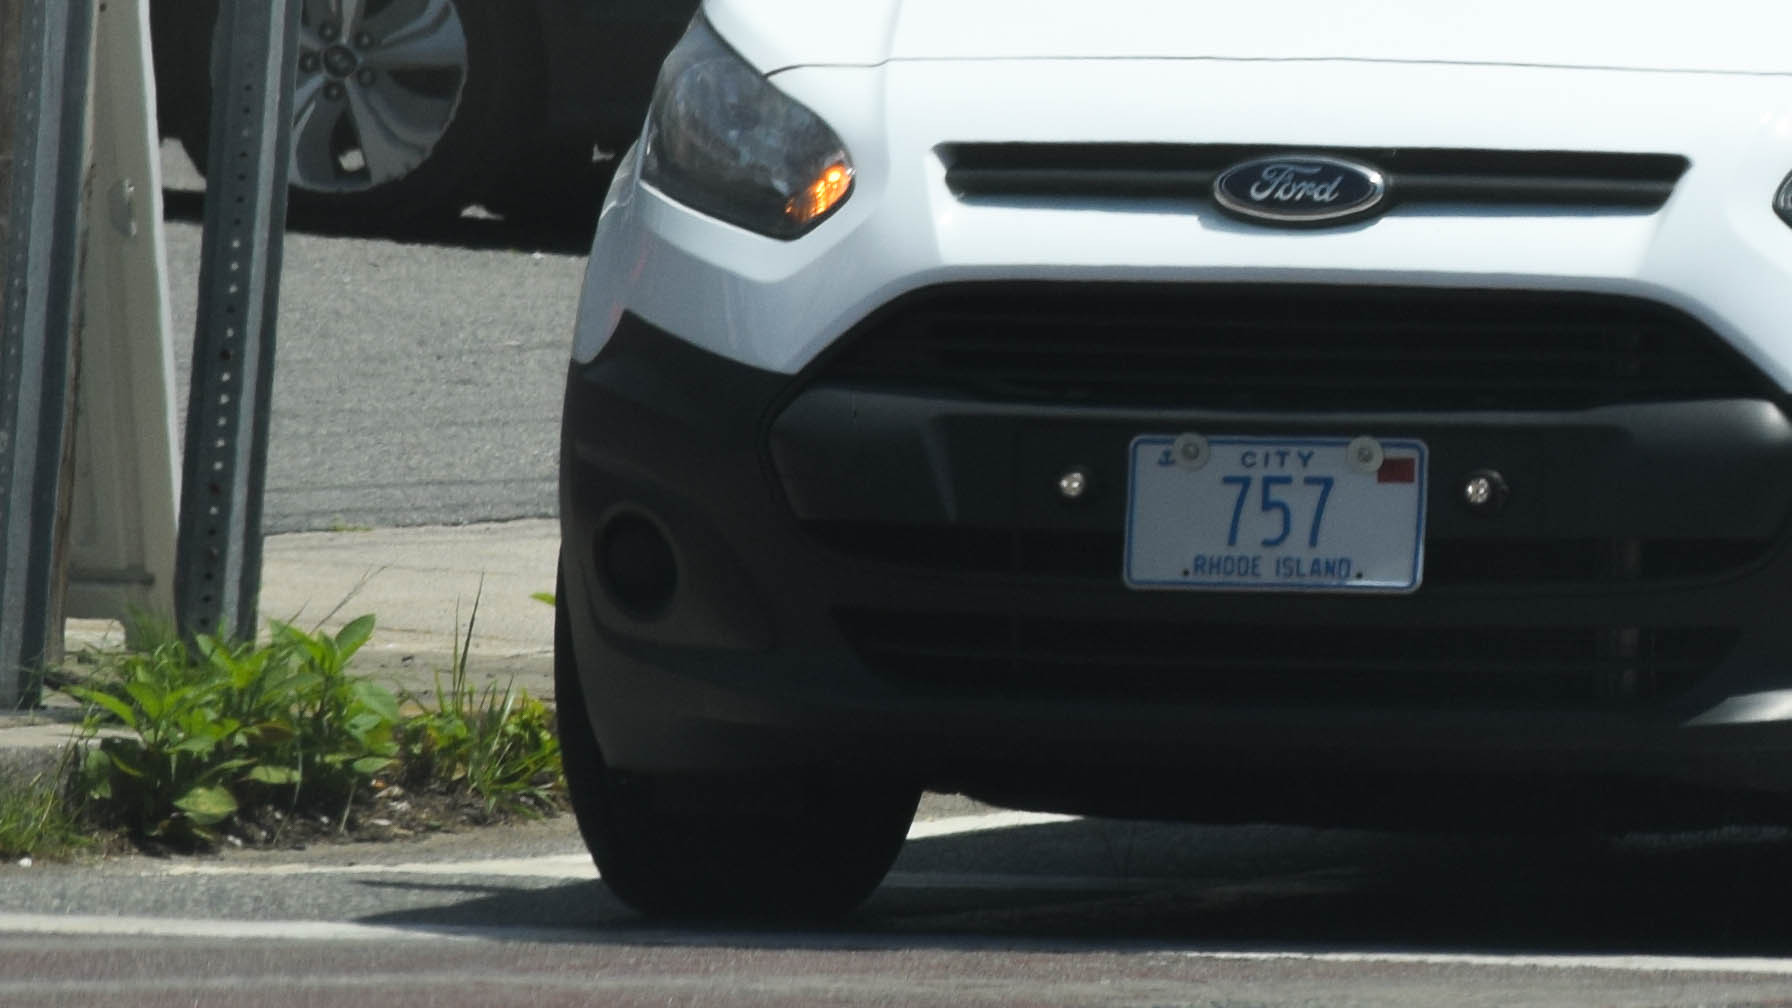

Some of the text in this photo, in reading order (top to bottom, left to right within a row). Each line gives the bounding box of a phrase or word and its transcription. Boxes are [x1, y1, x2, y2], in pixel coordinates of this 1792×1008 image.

[1250, 163, 1344, 203] Ford
[1240, 450, 1316, 469] CITY
[1222, 475, 1336, 548] 757
[1193, 555, 1353, 579] RHODE ISLAND
